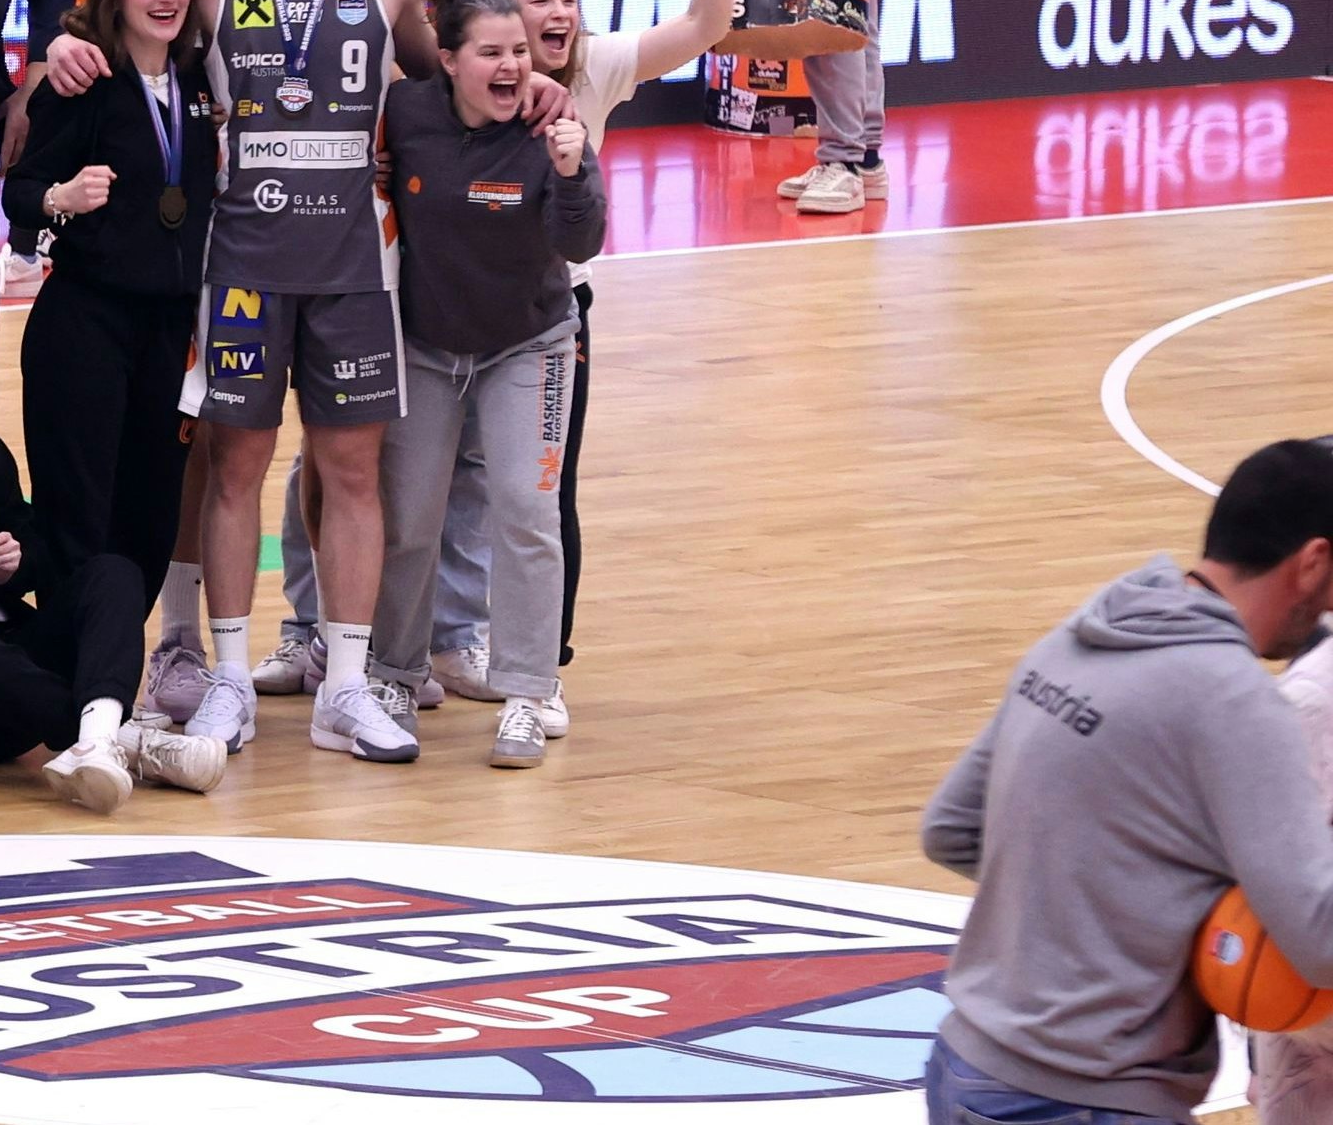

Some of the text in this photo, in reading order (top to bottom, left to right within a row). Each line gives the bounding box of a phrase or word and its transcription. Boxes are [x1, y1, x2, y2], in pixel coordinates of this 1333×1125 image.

[231, 52, 286, 70] tipico
[341, 39, 368, 93] 9
[295, 141, 362, 159] UNITED
[293, 194, 339, 206] GLAS
[293, 207, 347, 216] HOLZINGER
[220, 286, 262, 320] N
[221, 350, 256, 371] NV
[208, 386, 246, 405] Kempa
[348, 386, 397, 404] happyland
[543, 353, 558, 442] BASKETBALL
[1017, 670, 1104, 737] austria
[310, 985, 673, 1042] CUP
